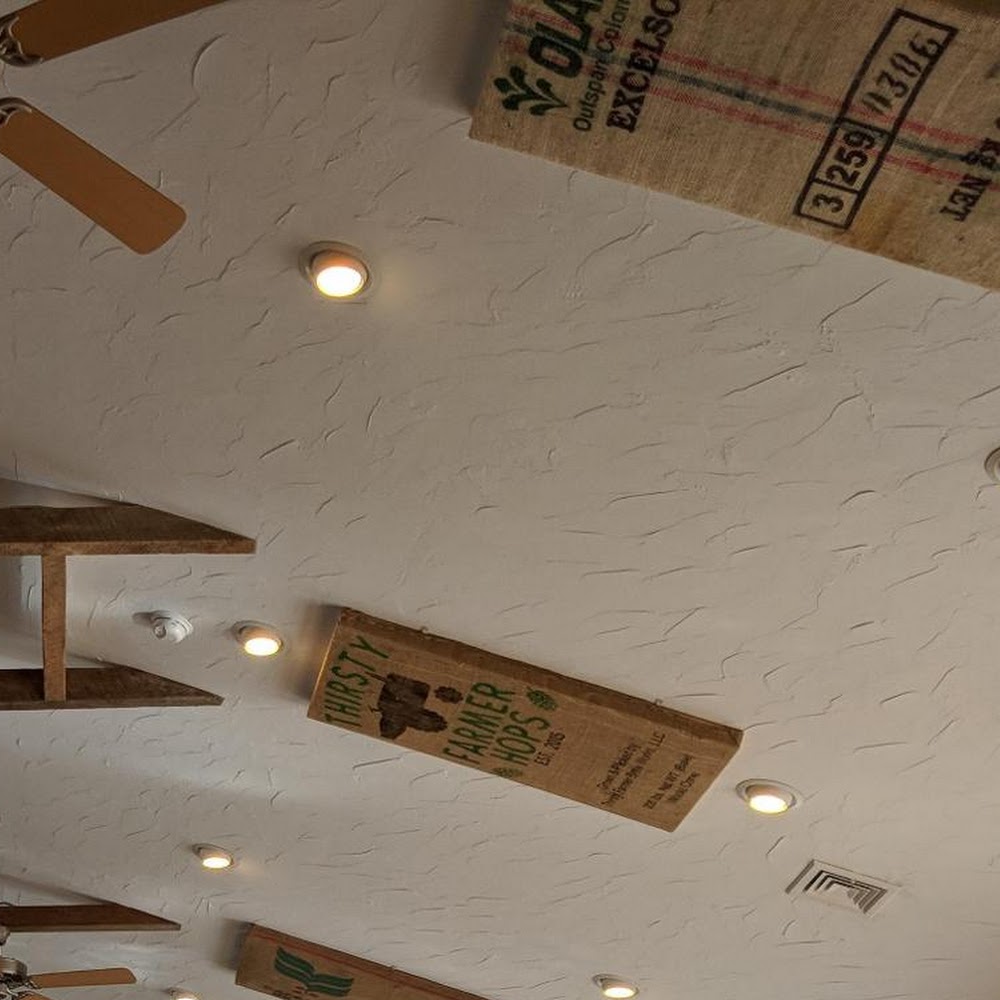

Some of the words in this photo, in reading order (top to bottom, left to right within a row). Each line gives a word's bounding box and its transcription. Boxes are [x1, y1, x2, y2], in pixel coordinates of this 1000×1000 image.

[826, 130, 876, 187] 259
[812, 192, 843, 214] 3
[322, 636, 389, 728] THIRSTY
[443, 682, 516, 764] FARMER
[490, 711, 551, 766] HOPS
